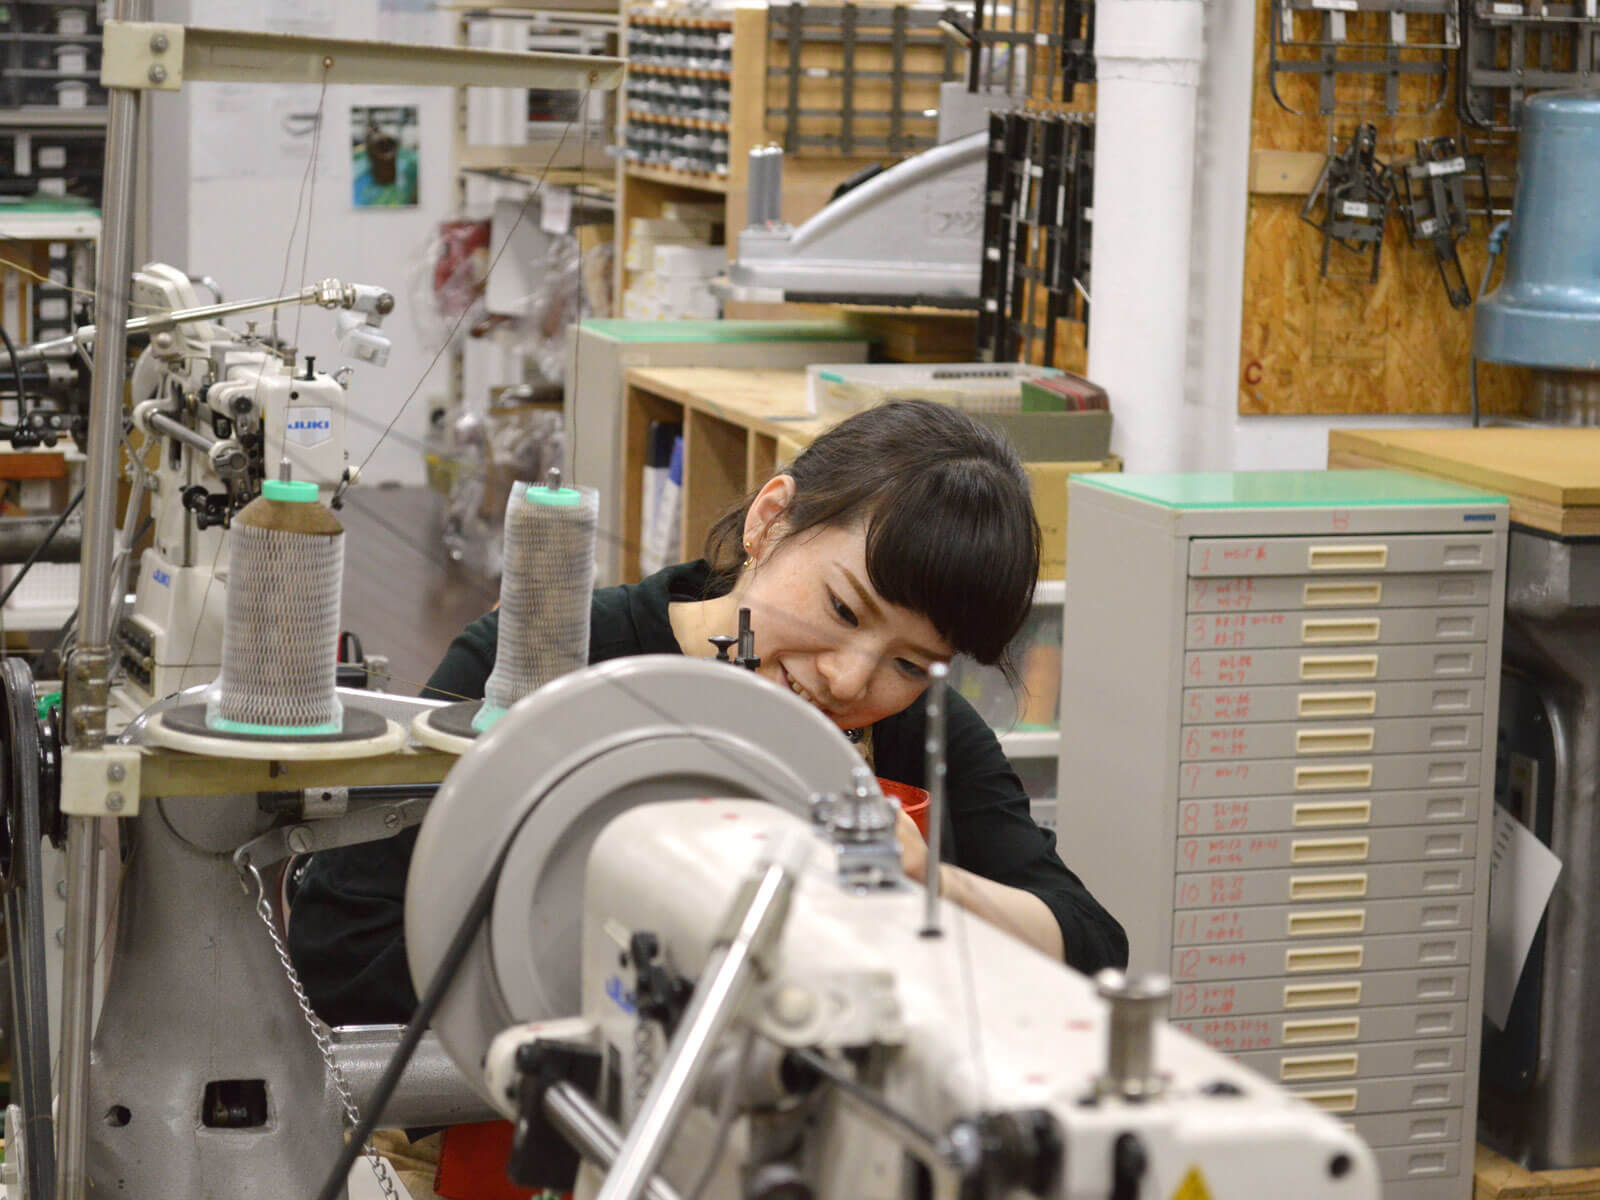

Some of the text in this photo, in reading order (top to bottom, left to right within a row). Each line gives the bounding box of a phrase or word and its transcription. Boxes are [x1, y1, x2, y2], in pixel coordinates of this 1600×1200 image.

[287, 420, 329, 430] JUKI
[1200, 546, 1210, 571] 1
[1194, 580, 1208, 609] 2
[1193, 615, 1206, 643] 3
[1189, 656, 1203, 683] 4
[1189, 692, 1203, 721] 5
[1186, 728, 1200, 758] 6
[1186, 765, 1201, 793] 7
[1183, 802, 1200, 834] 8
[1184, 839, 1199, 868] 9
[1179, 880, 1200, 904] 10
[1178, 914, 1198, 940] 11
[1179, 947, 1200, 979] 12
[1177, 983, 1198, 1016] 13
